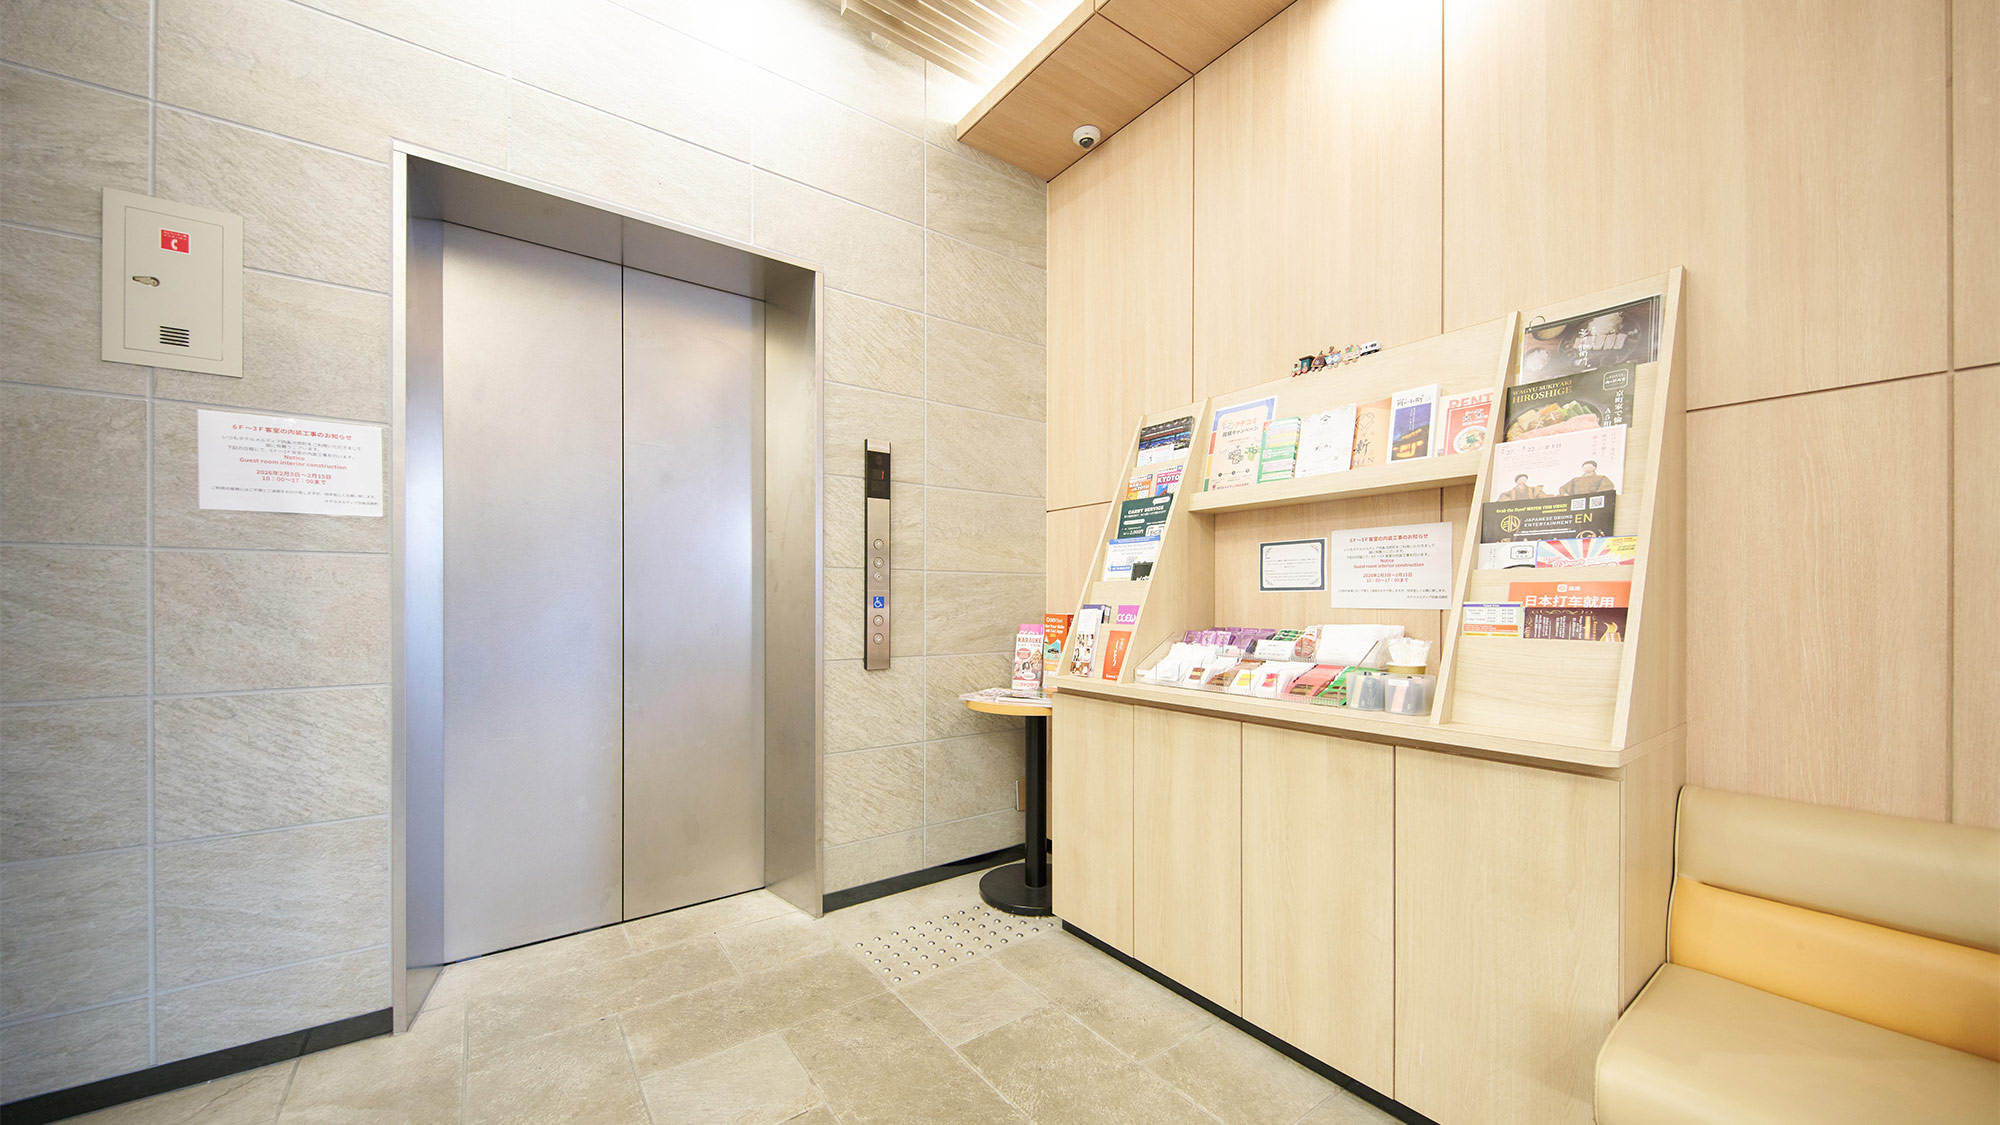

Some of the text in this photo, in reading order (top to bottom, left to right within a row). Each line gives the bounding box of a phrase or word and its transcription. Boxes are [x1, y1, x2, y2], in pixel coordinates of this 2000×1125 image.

[1512, 386, 1572, 404] HIROSHIGE
[1513, 386, 1538, 395] WAGYU
[306, 462, 347, 470] construction
[1157, 474, 1180, 484] KYOTO
[1144, 505, 1164, 513] SERVICE
[1575, 513, 1593, 524] EN
[1525, 595, 1614, 608] 日本打车就用
